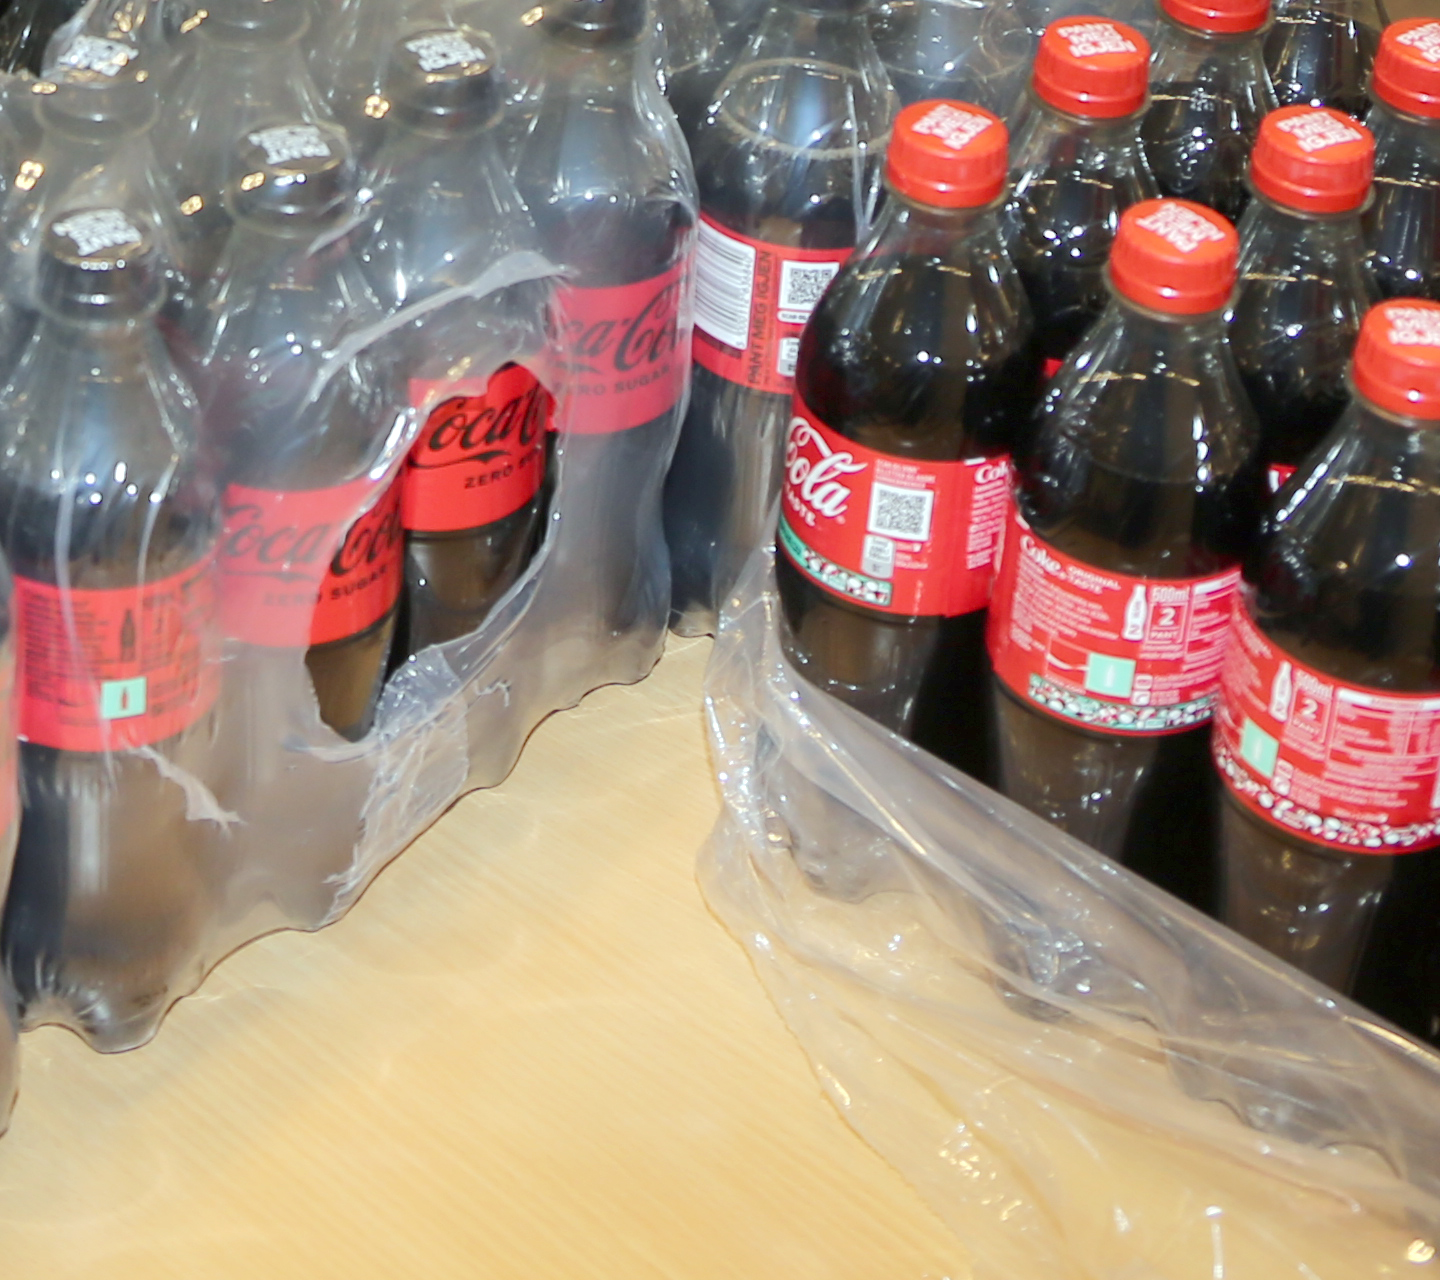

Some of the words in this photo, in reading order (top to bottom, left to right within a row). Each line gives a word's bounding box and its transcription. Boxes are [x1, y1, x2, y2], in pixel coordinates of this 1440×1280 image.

[614, 365, 672, 395] SUGAR
[464, 464, 514, 490] ZERO
[1020, 535, 1061, 574] Coke
[330, 563, 390, 601] SUGAR
[1068, 564, 1121, 591] ORIGINAL
[1159, 607, 1176, 627] 2
[1301, 697, 1318, 720] 2
